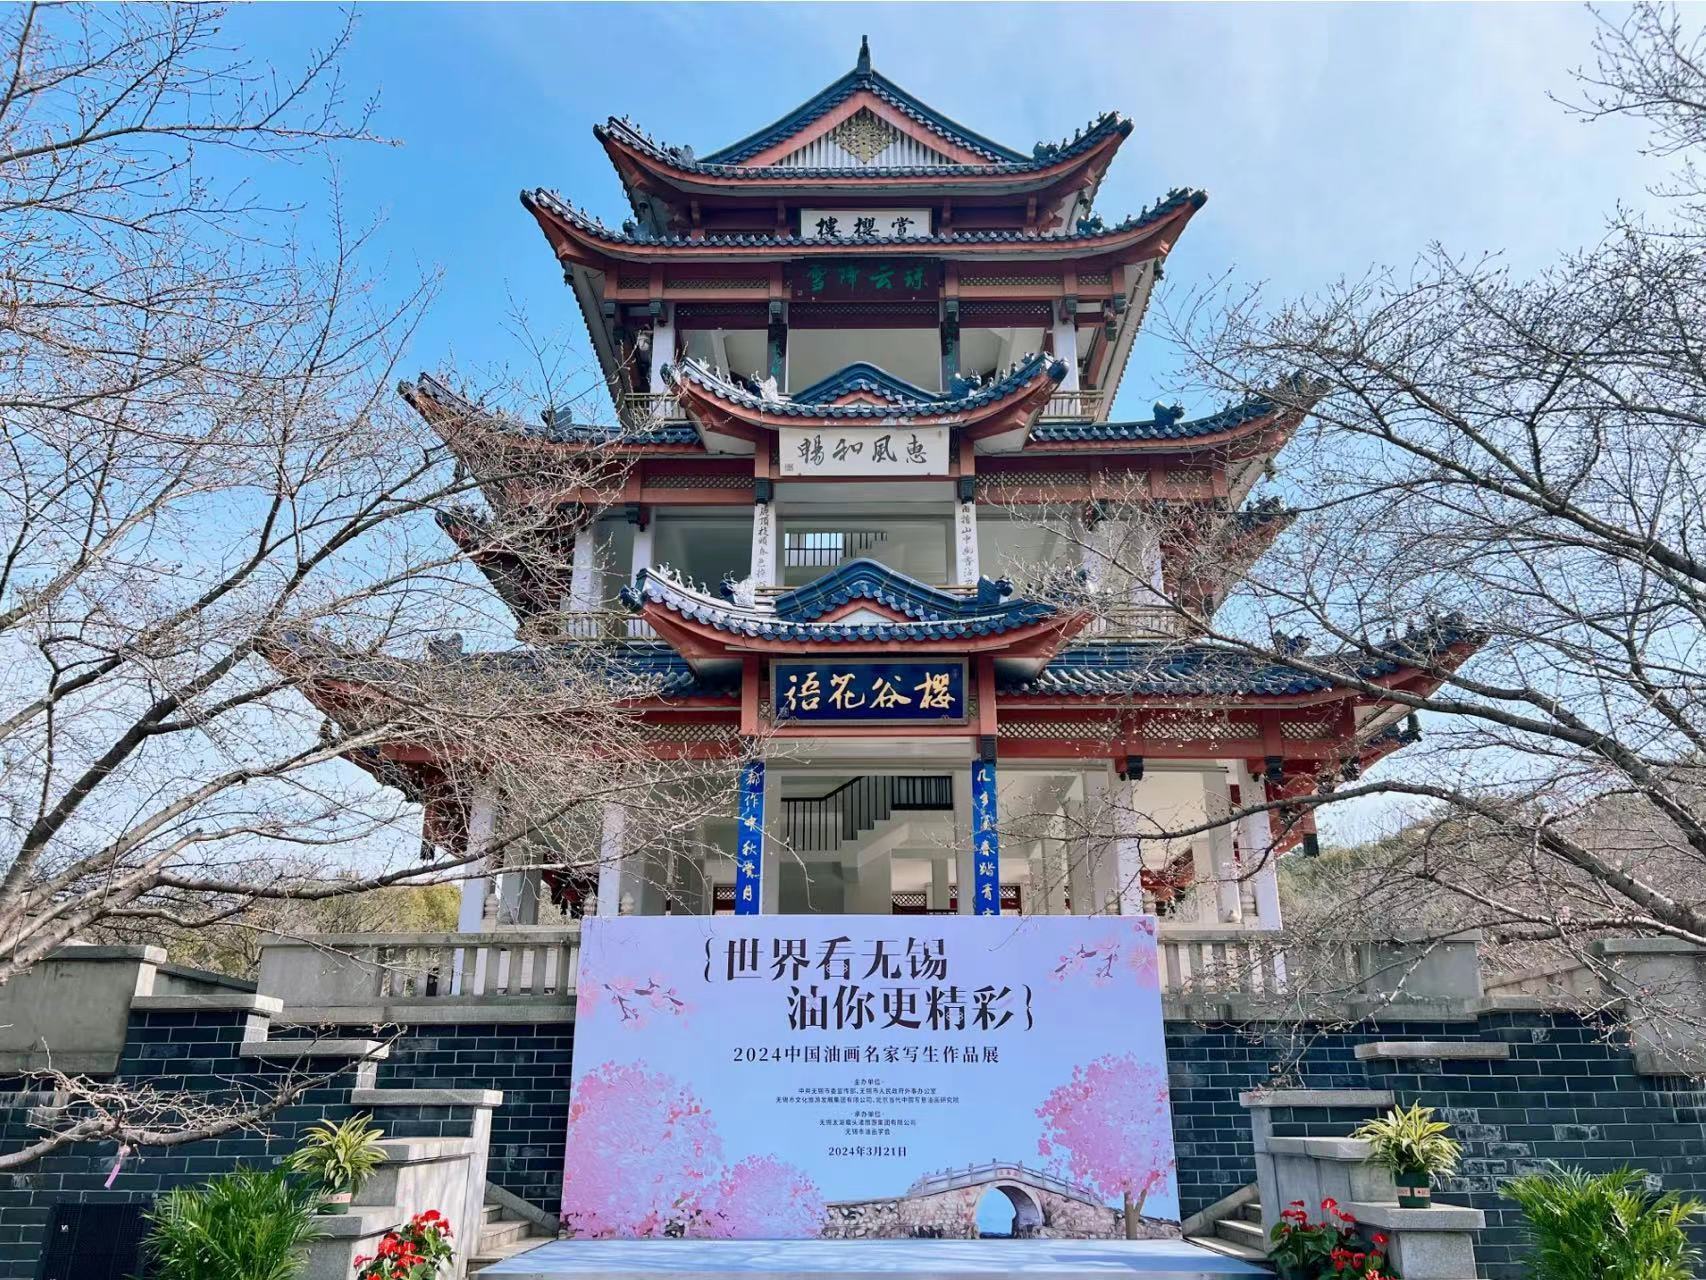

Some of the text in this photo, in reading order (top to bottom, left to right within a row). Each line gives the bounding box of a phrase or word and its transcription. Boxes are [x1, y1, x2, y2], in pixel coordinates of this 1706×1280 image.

[733, 1045, 1000, 1064] 2024中国油画名家写生作品展
[828, 1145, 908, 1158] 2024年3月21日
